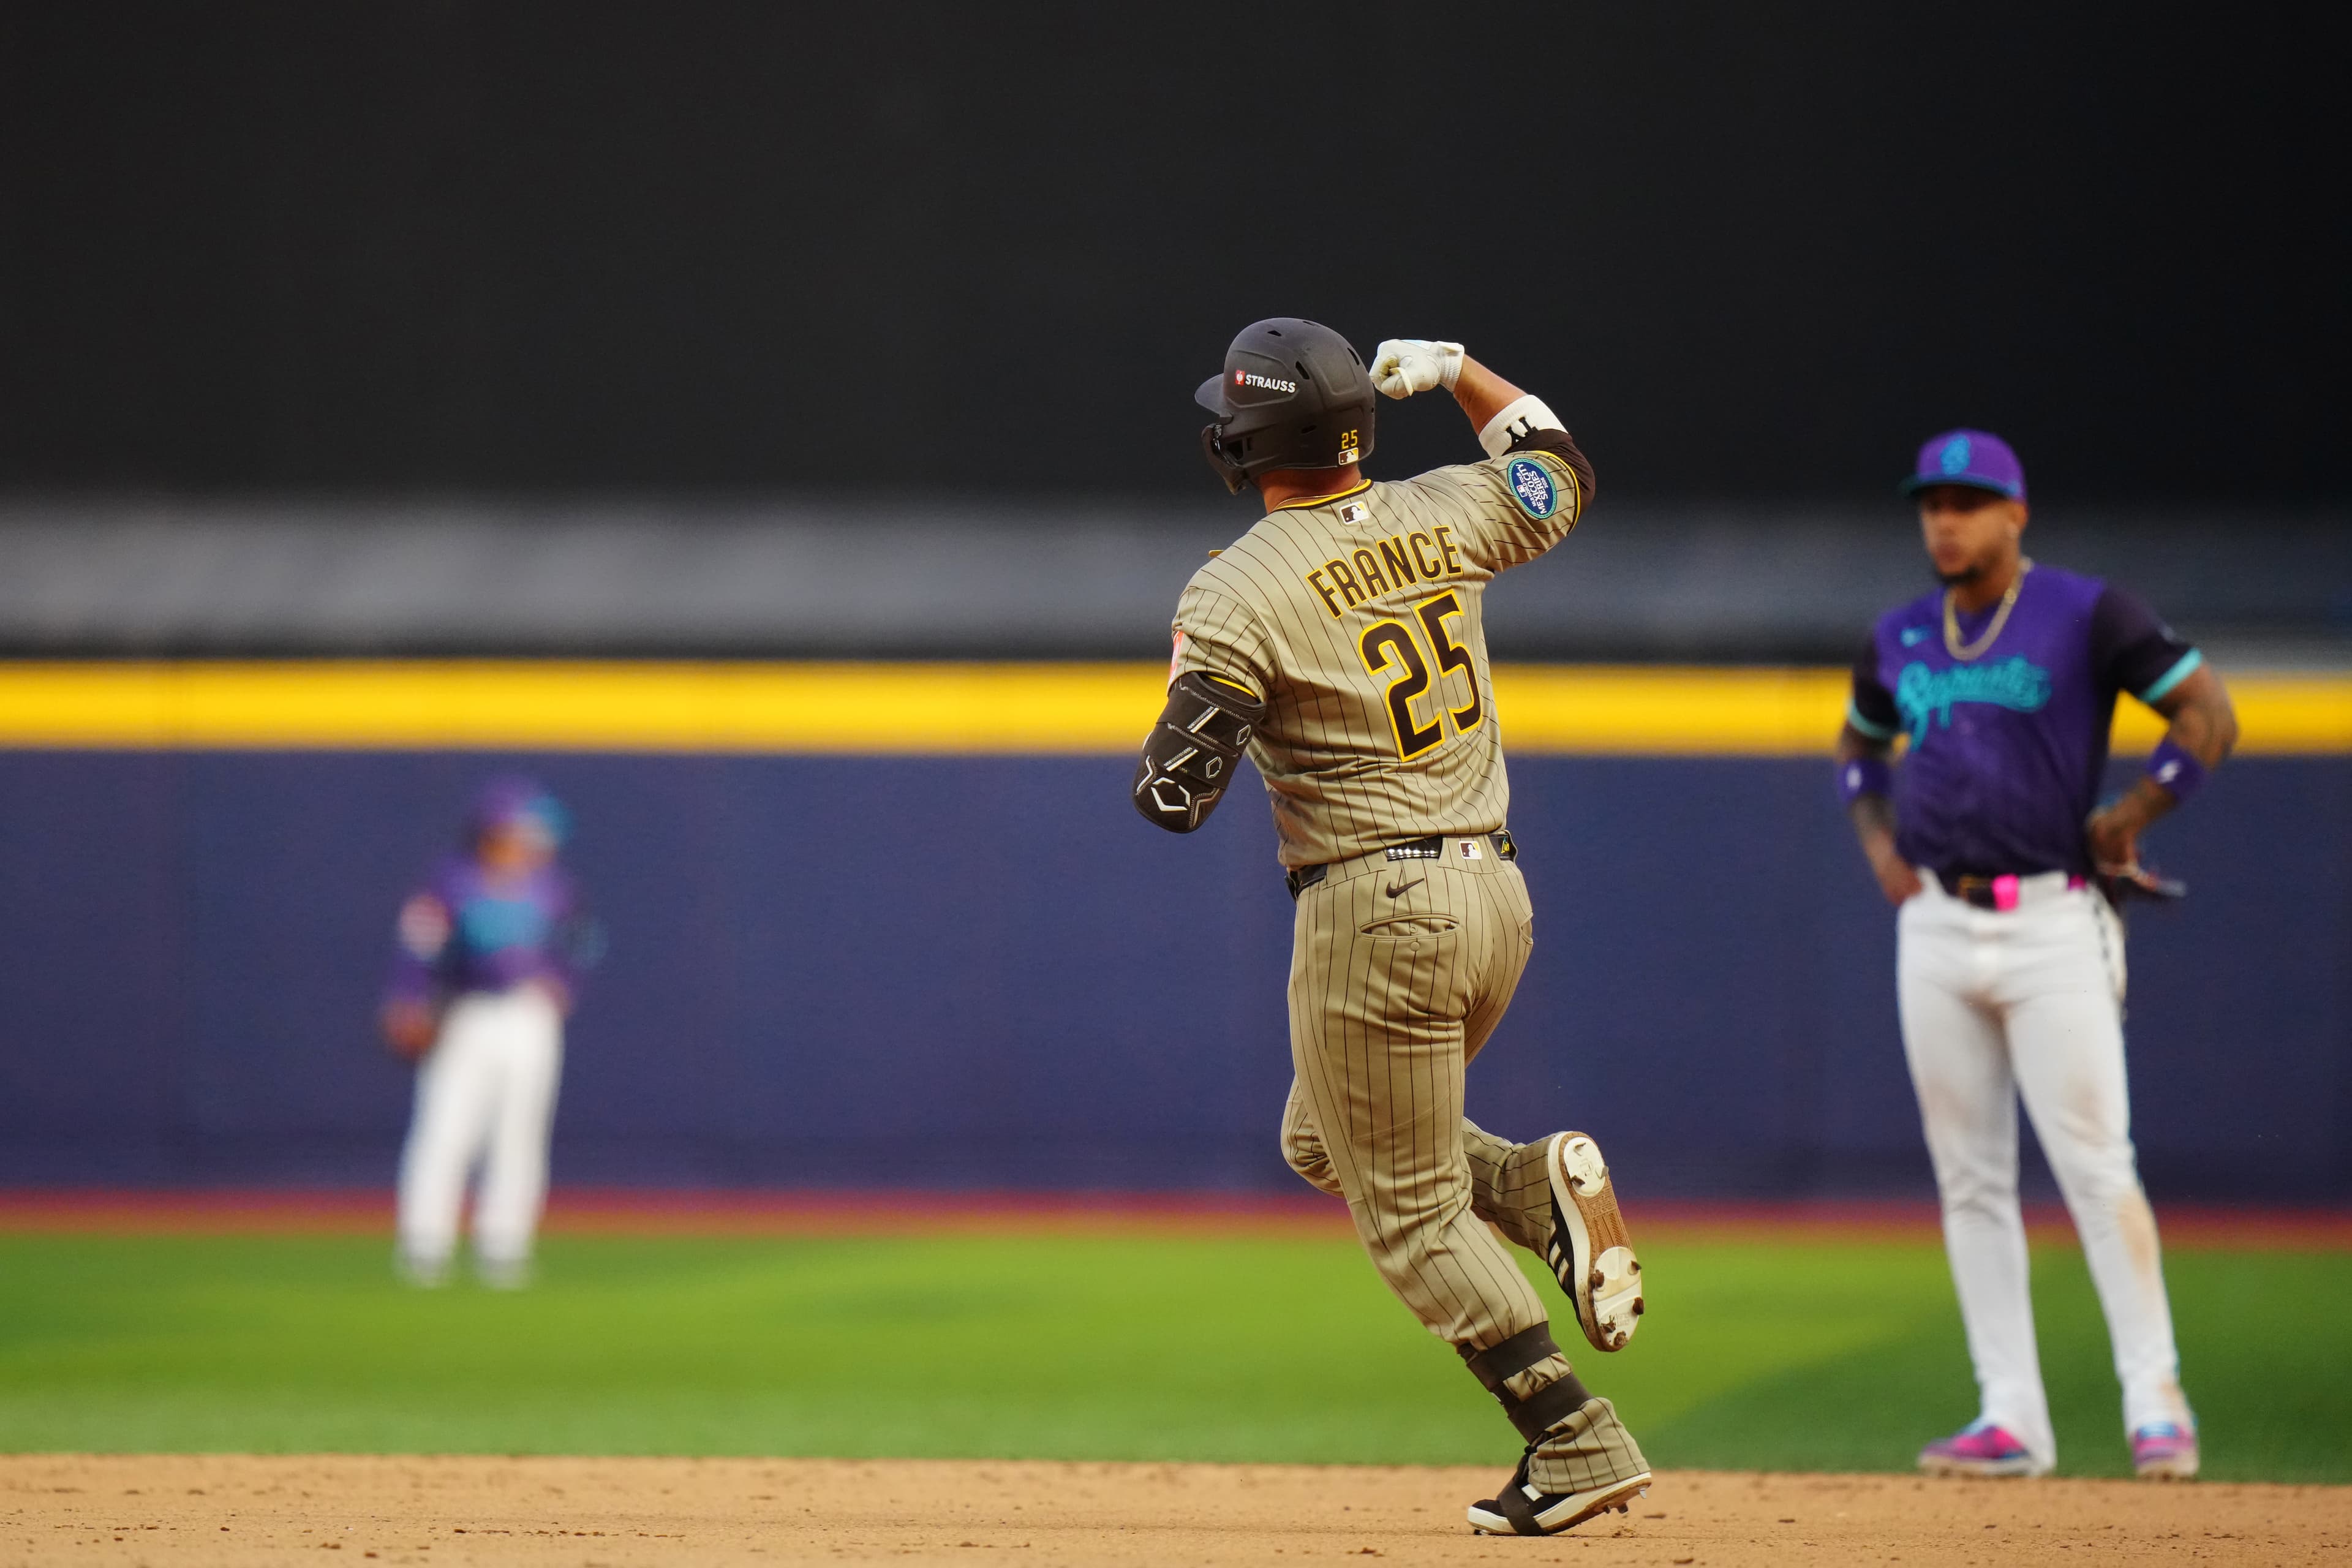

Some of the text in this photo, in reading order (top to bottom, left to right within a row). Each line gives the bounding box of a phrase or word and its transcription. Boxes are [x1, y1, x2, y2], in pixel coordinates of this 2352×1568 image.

[1245, 374, 1296, 393] STRAUSS
[1341, 429, 1358, 449] 25
[1516, 472, 1525, 483] TOUR
[1529, 470, 1548, 500] SERIES
[1540, 477, 1549, 489] 2026
[1515, 464, 1547, 514] MEXICO CITY
[1523, 483, 1532, 498] WORLD
[1306, 526, 1462, 619] FRANCE
[1359, 589, 1481, 762] 25
